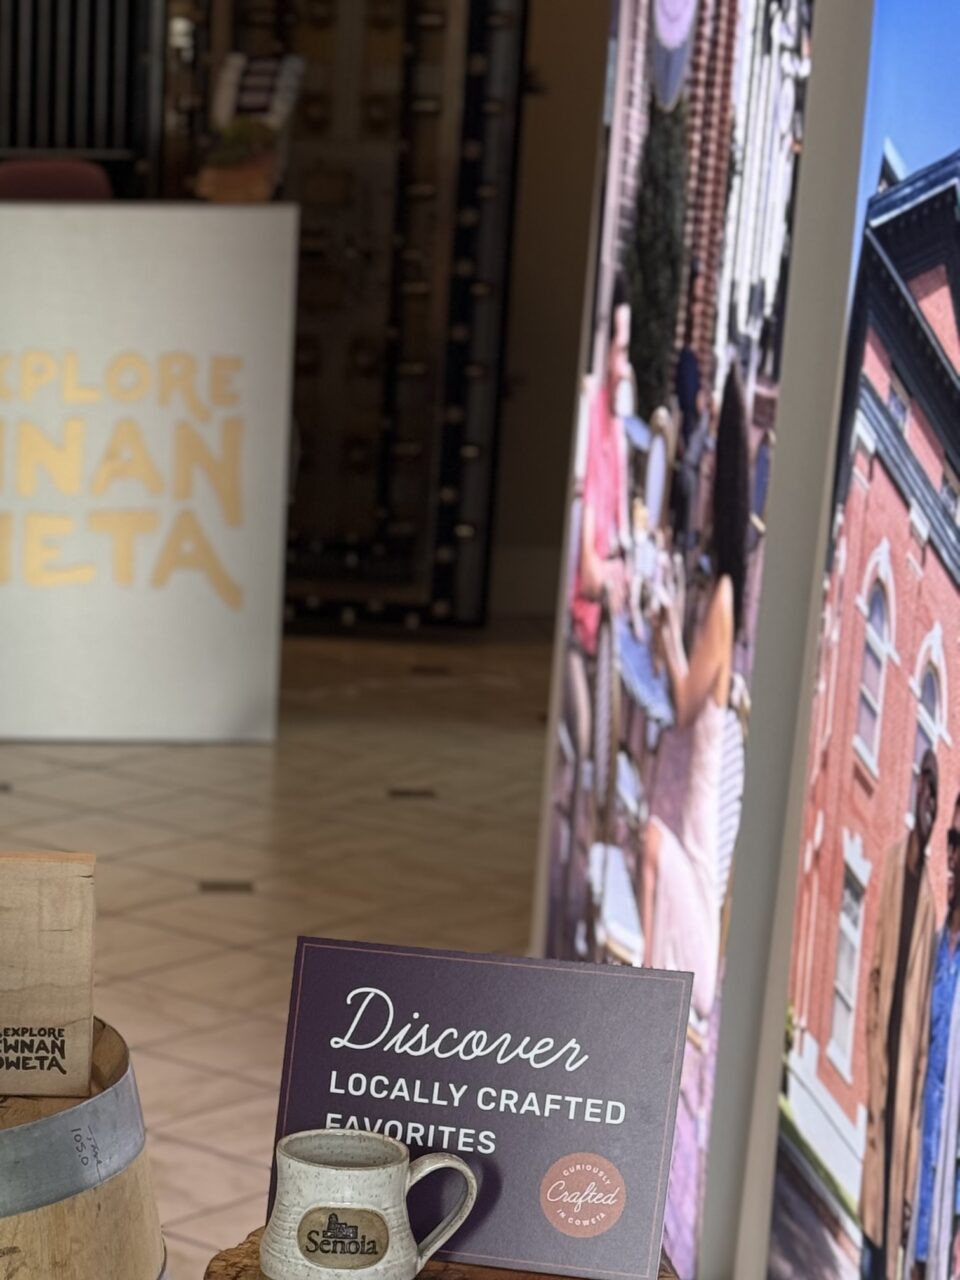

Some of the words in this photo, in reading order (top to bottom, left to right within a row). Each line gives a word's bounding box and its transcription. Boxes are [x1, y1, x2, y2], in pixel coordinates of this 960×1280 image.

[3, 1027, 64, 1041] EXPLORE
[330, 986, 590, 1073] Discover
[329, 1070, 468, 1107] LOCALLY
[477, 1086, 627, 1126] CRAFTED
[562, 1163, 612, 1185] CURIOUSLY
[547, 1179, 620, 1213] Crafted
[556, 1208, 567, 1219] IN
[567, 1212, 607, 1227] COWETA
[305, 1229, 379, 1257] Senoia
